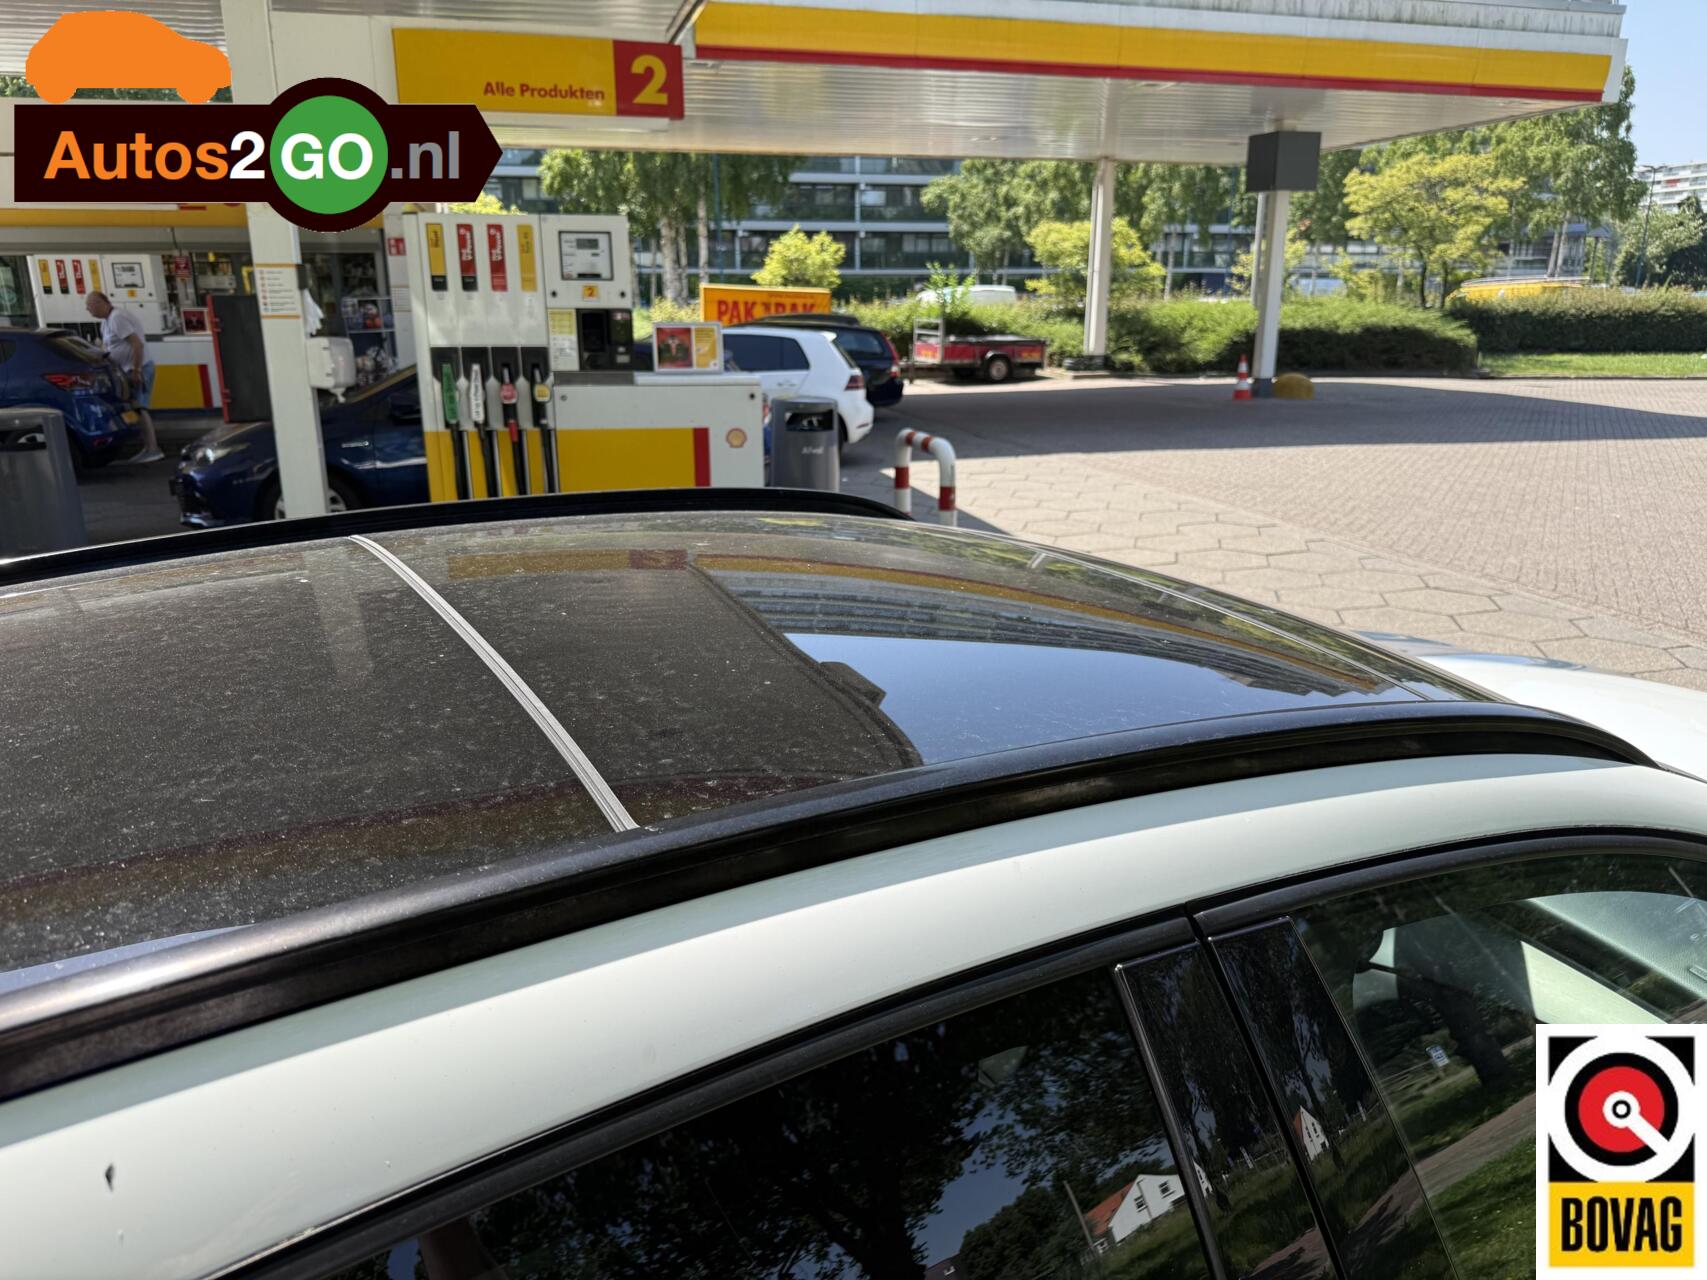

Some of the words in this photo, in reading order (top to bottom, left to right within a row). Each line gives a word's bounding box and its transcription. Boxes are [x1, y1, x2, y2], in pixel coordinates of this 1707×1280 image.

[483, 81, 515, 97] Alle
[519, 83, 605, 100] Produkten
[630, 54, 669, 105] 2
[717, 300, 757, 325] PAK
